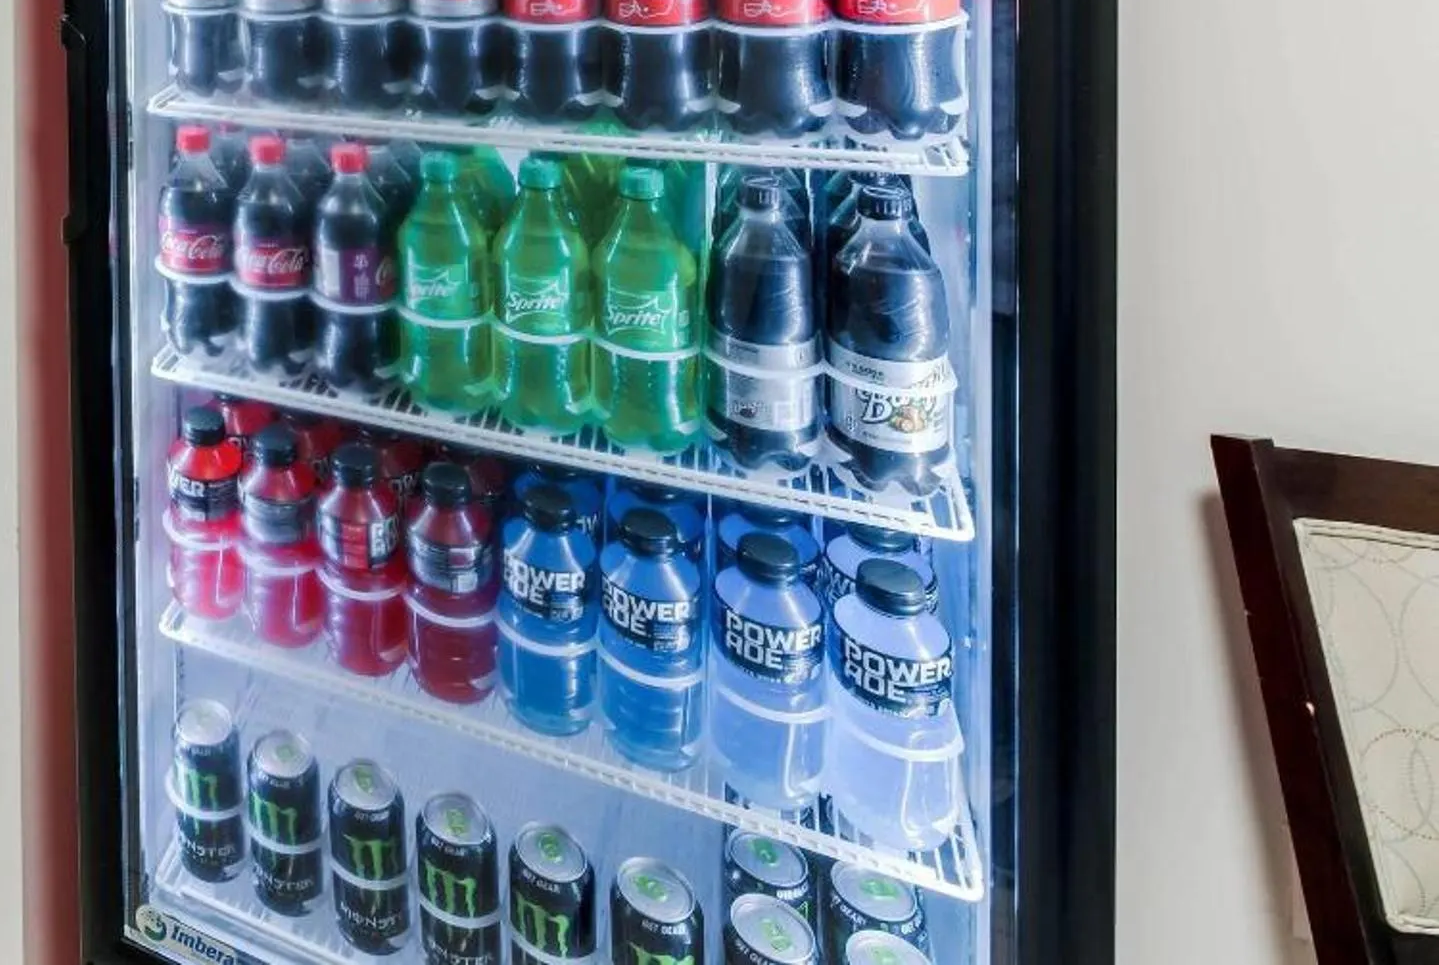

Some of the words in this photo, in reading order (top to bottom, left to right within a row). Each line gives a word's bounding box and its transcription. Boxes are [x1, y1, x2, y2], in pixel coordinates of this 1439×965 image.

[507, 291, 562, 312] Sprite
[725, 609, 822, 653] POWER
[725, 631, 784, 670] ADE
[843, 660, 907, 703] ADE
[844, 636, 951, 687] POWER
[170, 923, 235, 965] Imbera
